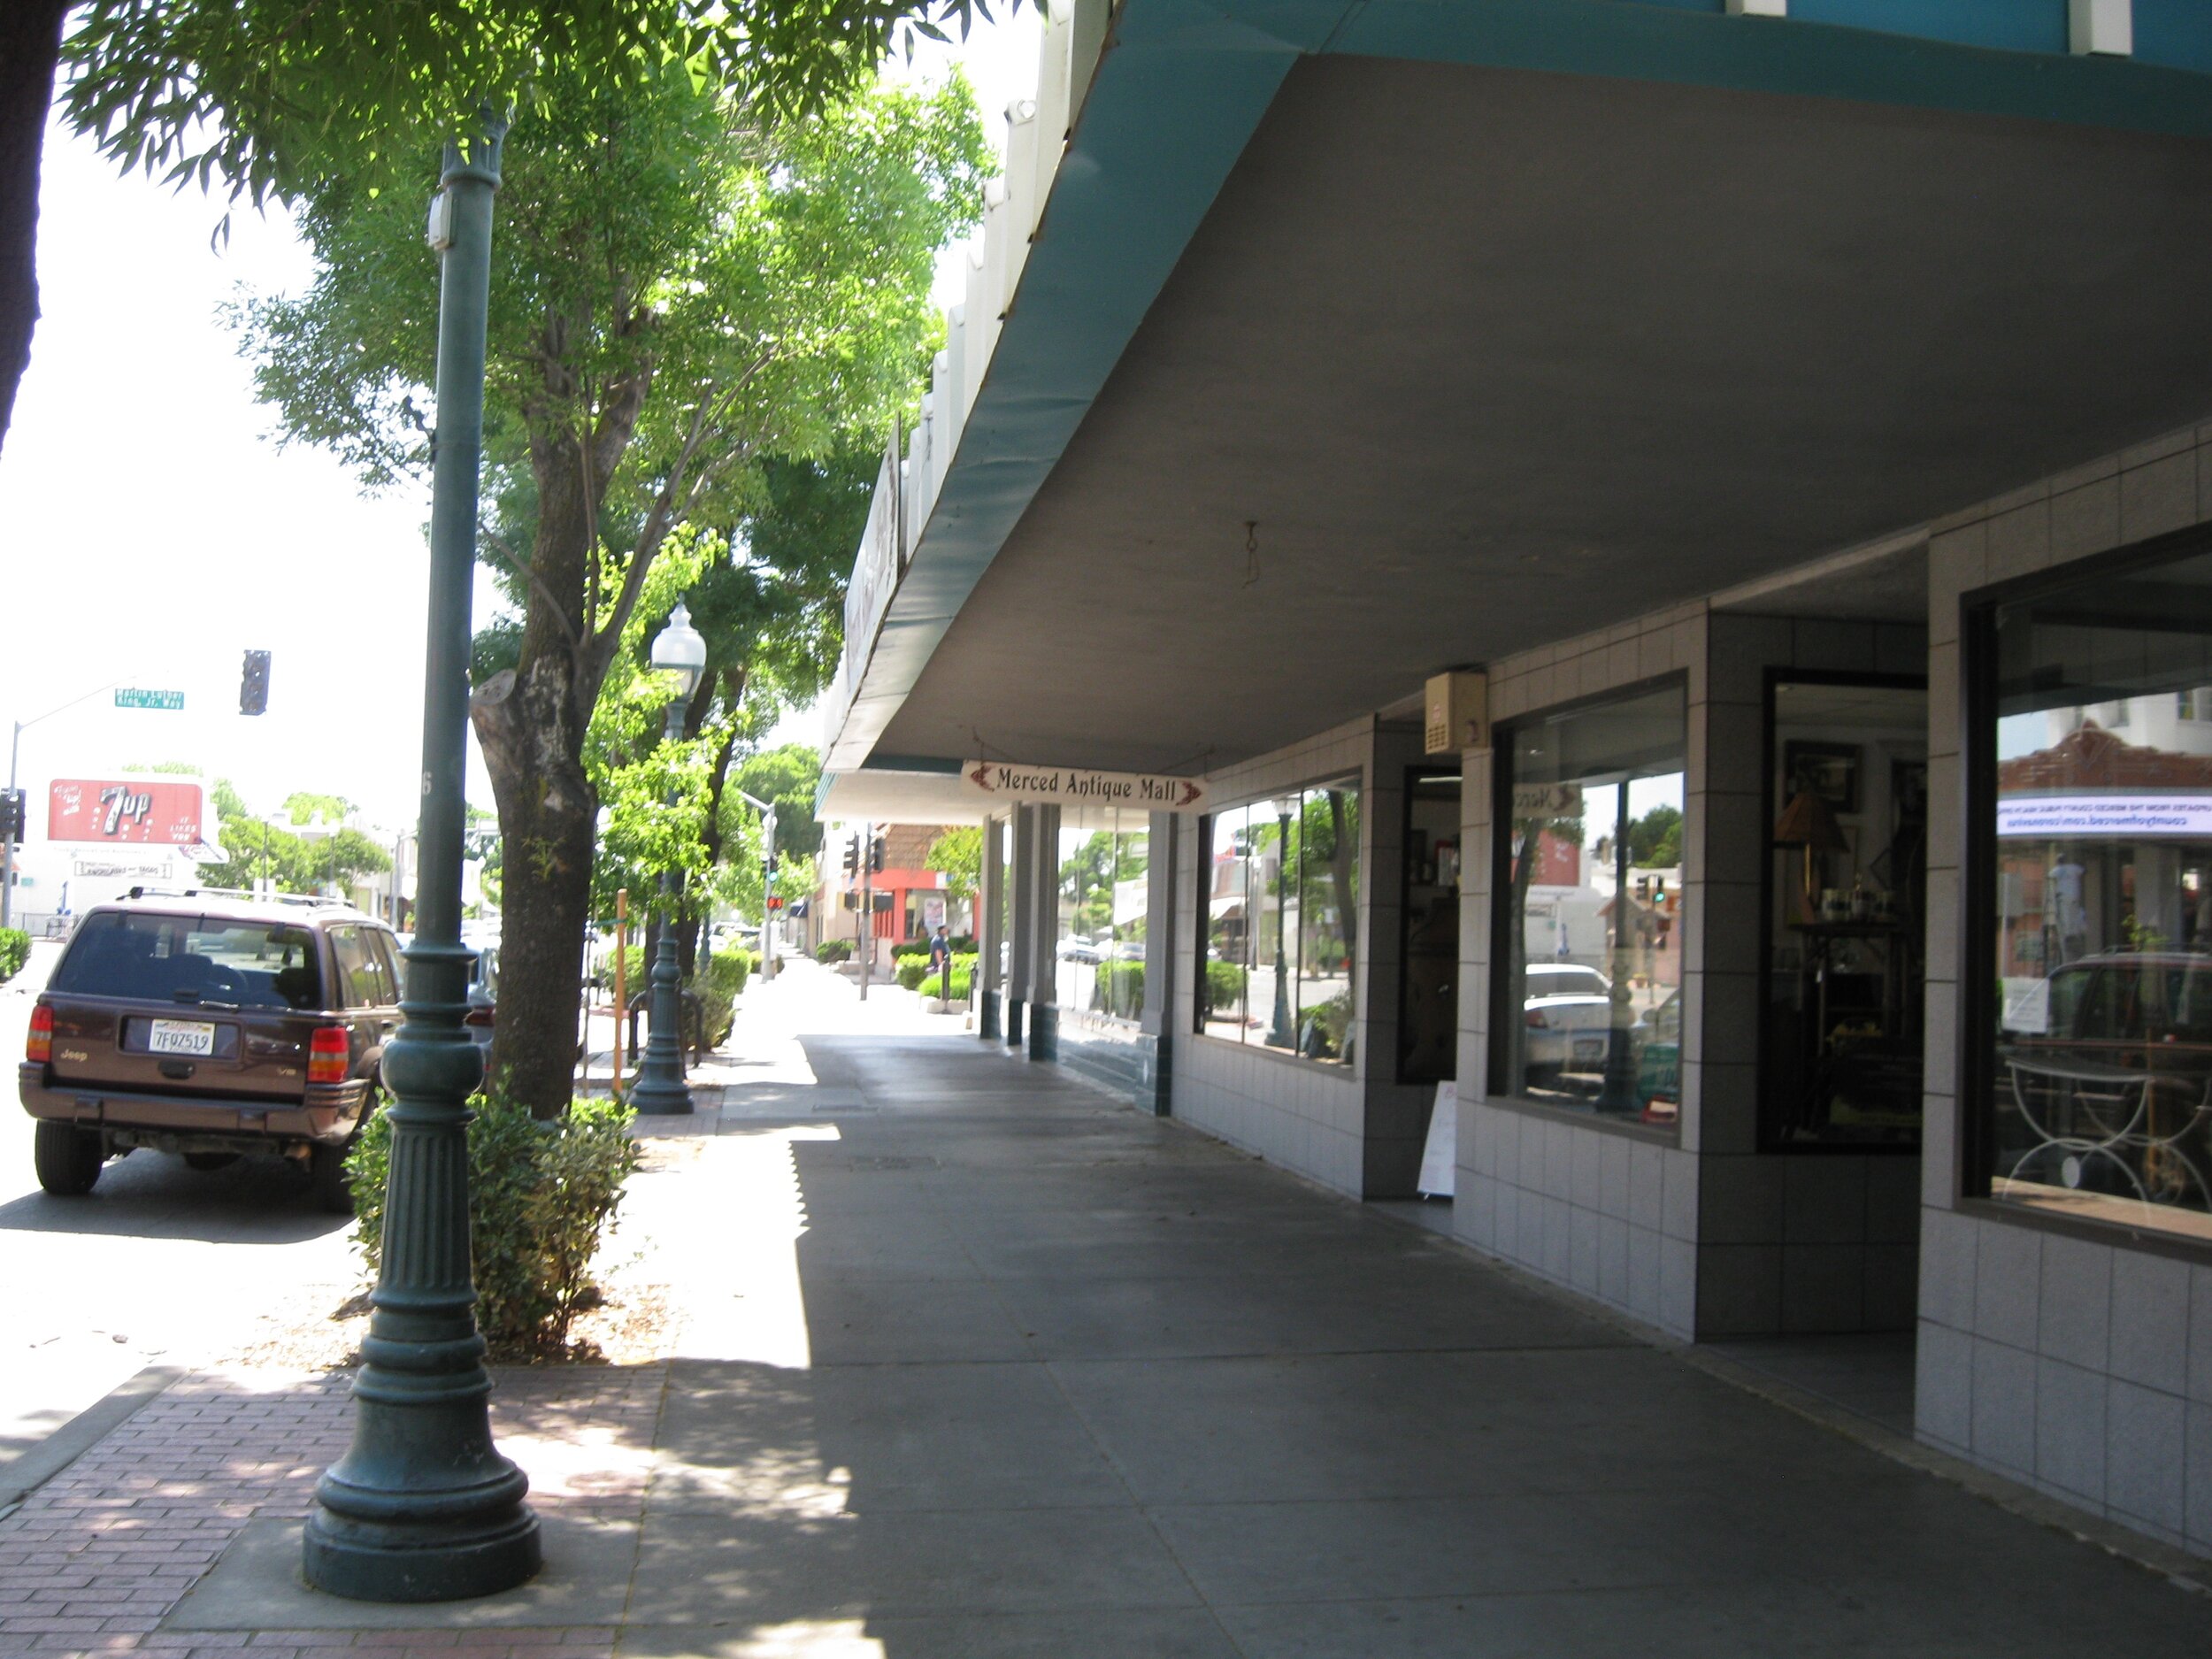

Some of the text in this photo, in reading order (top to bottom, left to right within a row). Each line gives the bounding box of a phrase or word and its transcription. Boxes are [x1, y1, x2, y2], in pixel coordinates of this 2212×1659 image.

[117, 688, 182, 699] Martin Luther
[163, 699, 182, 709] Way
[997, 768, 1175, 802] Merced Antique Mall
[170, 824, 196, 833] LIKES
[60, 1048, 88, 1062] Jeep
